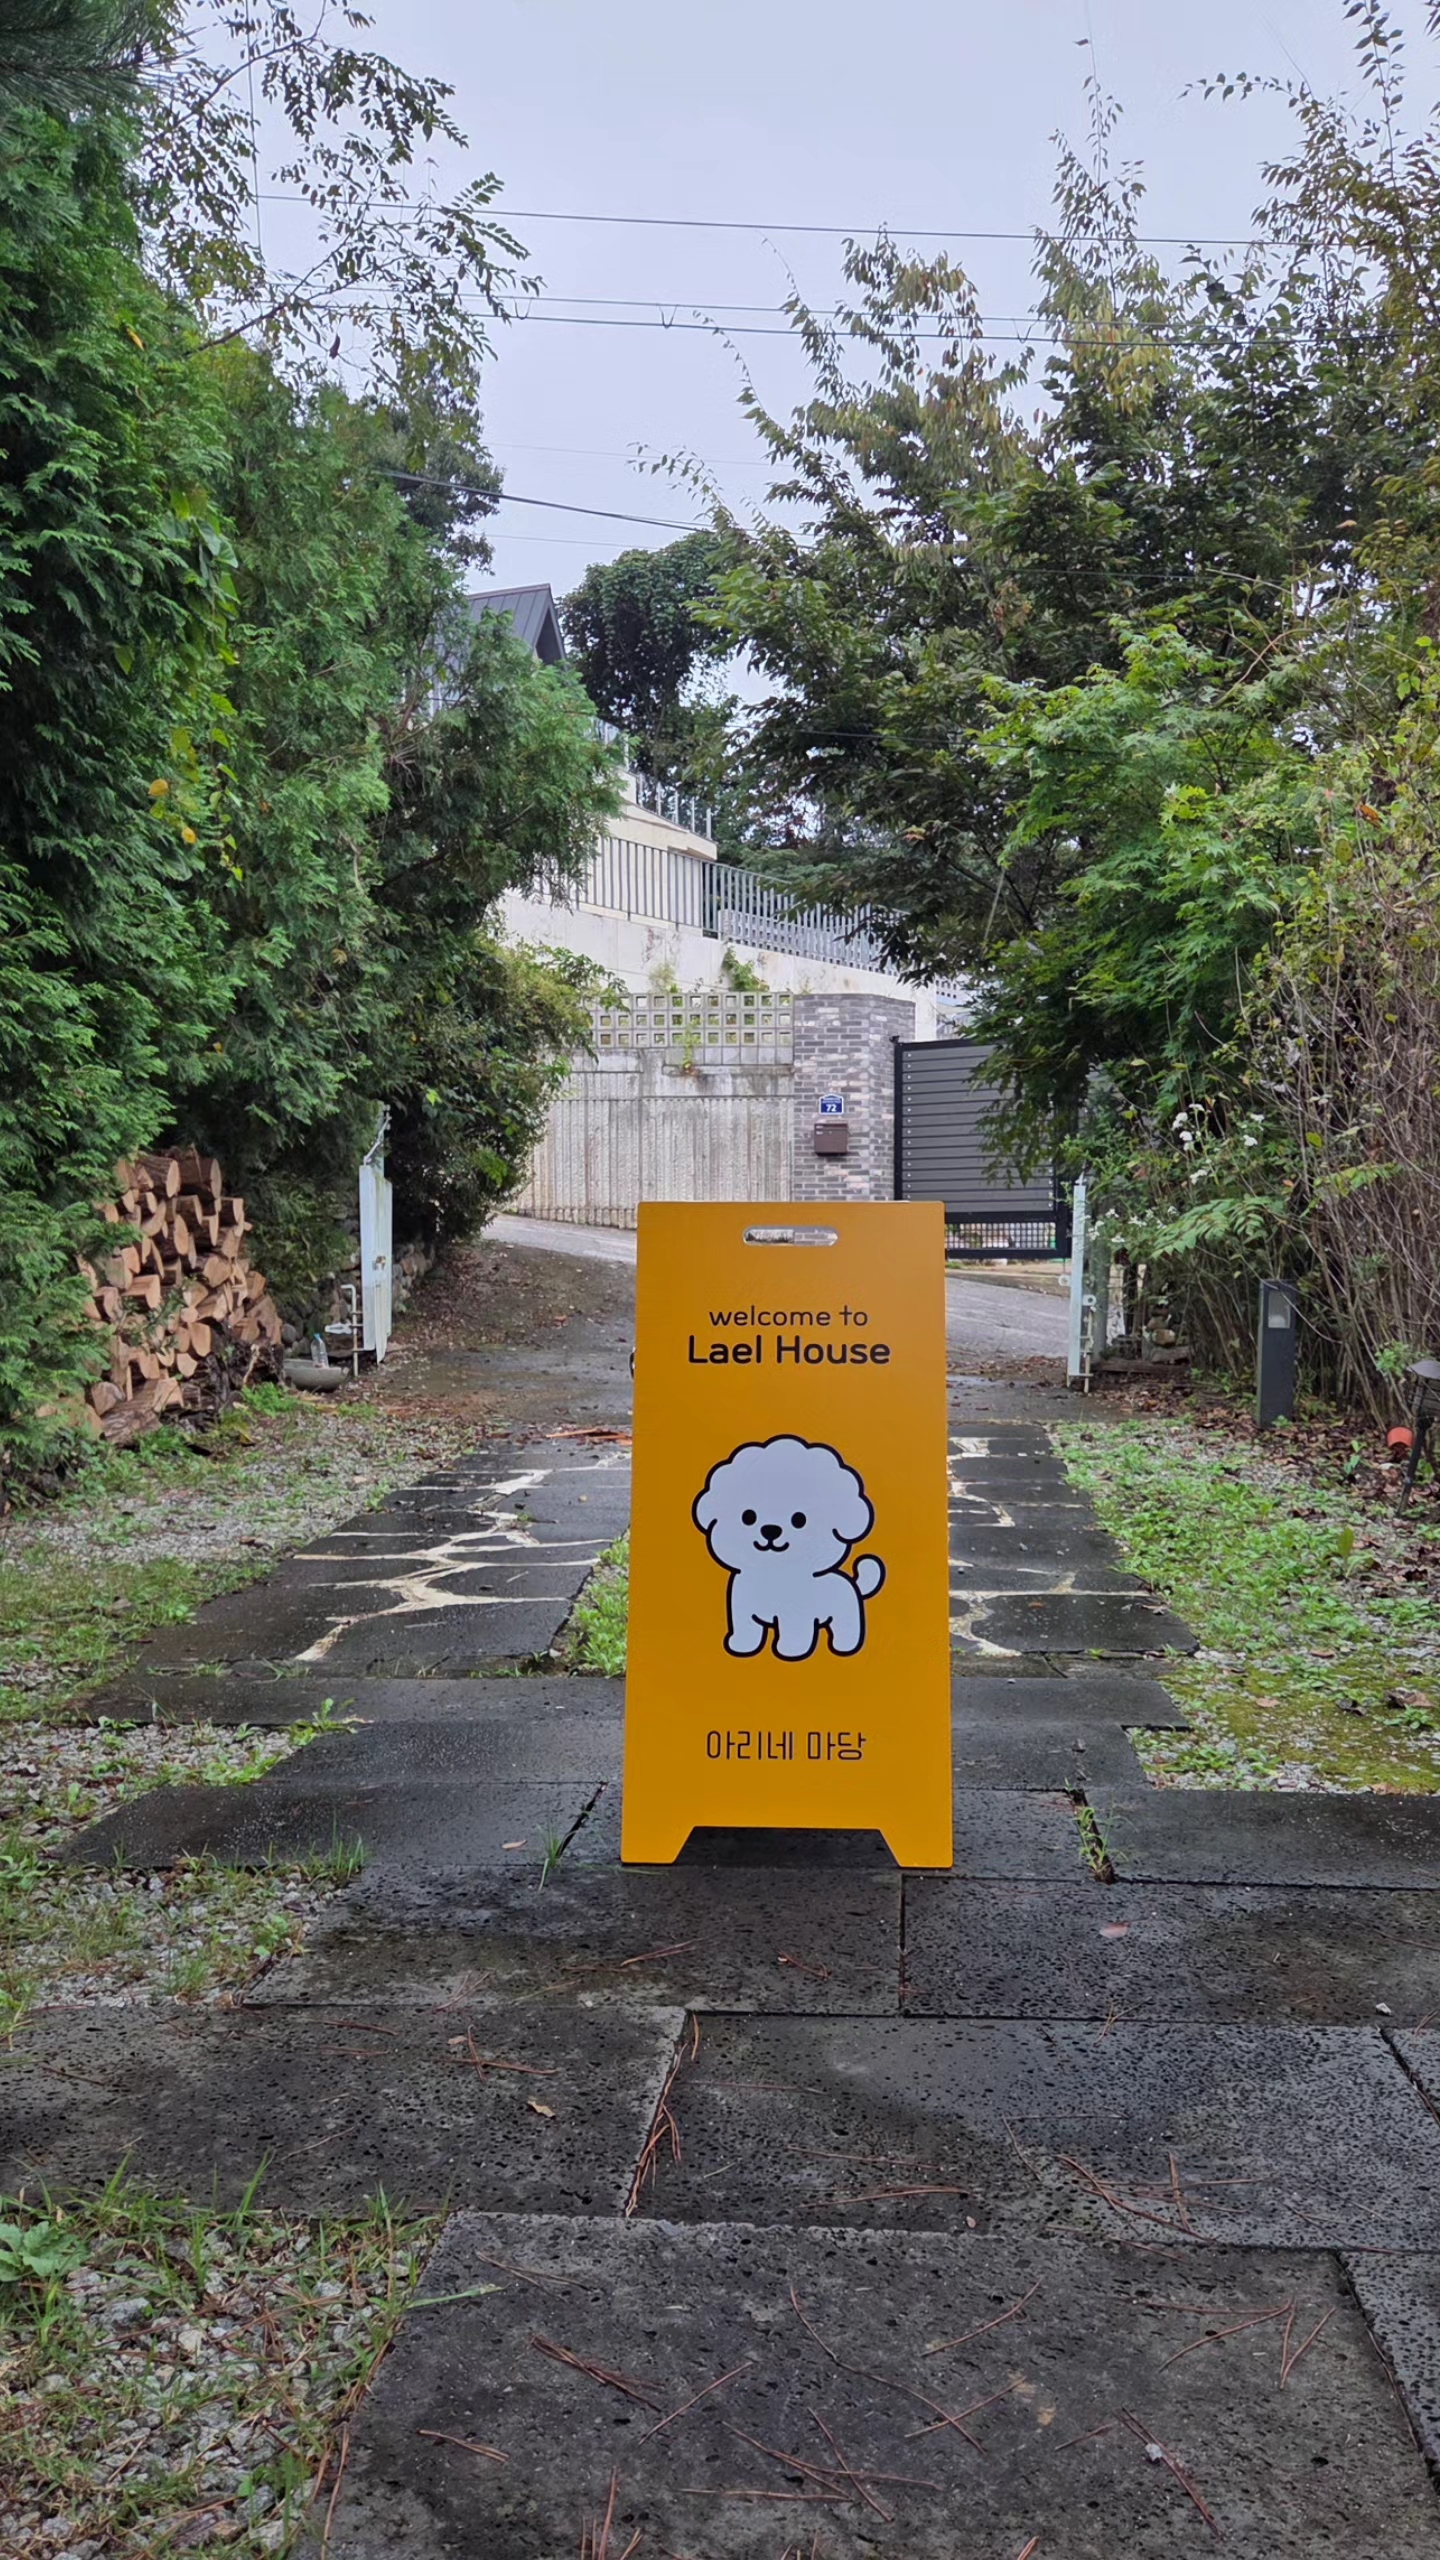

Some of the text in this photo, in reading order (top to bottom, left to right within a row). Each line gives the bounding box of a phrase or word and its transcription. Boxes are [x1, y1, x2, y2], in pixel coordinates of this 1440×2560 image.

[825, 1103, 837, 1112] 72
[709, 1305, 868, 1326] welcome to
[688, 1334, 890, 1364] Lael House
[706, 1730, 866, 1761] 아리네 마당
